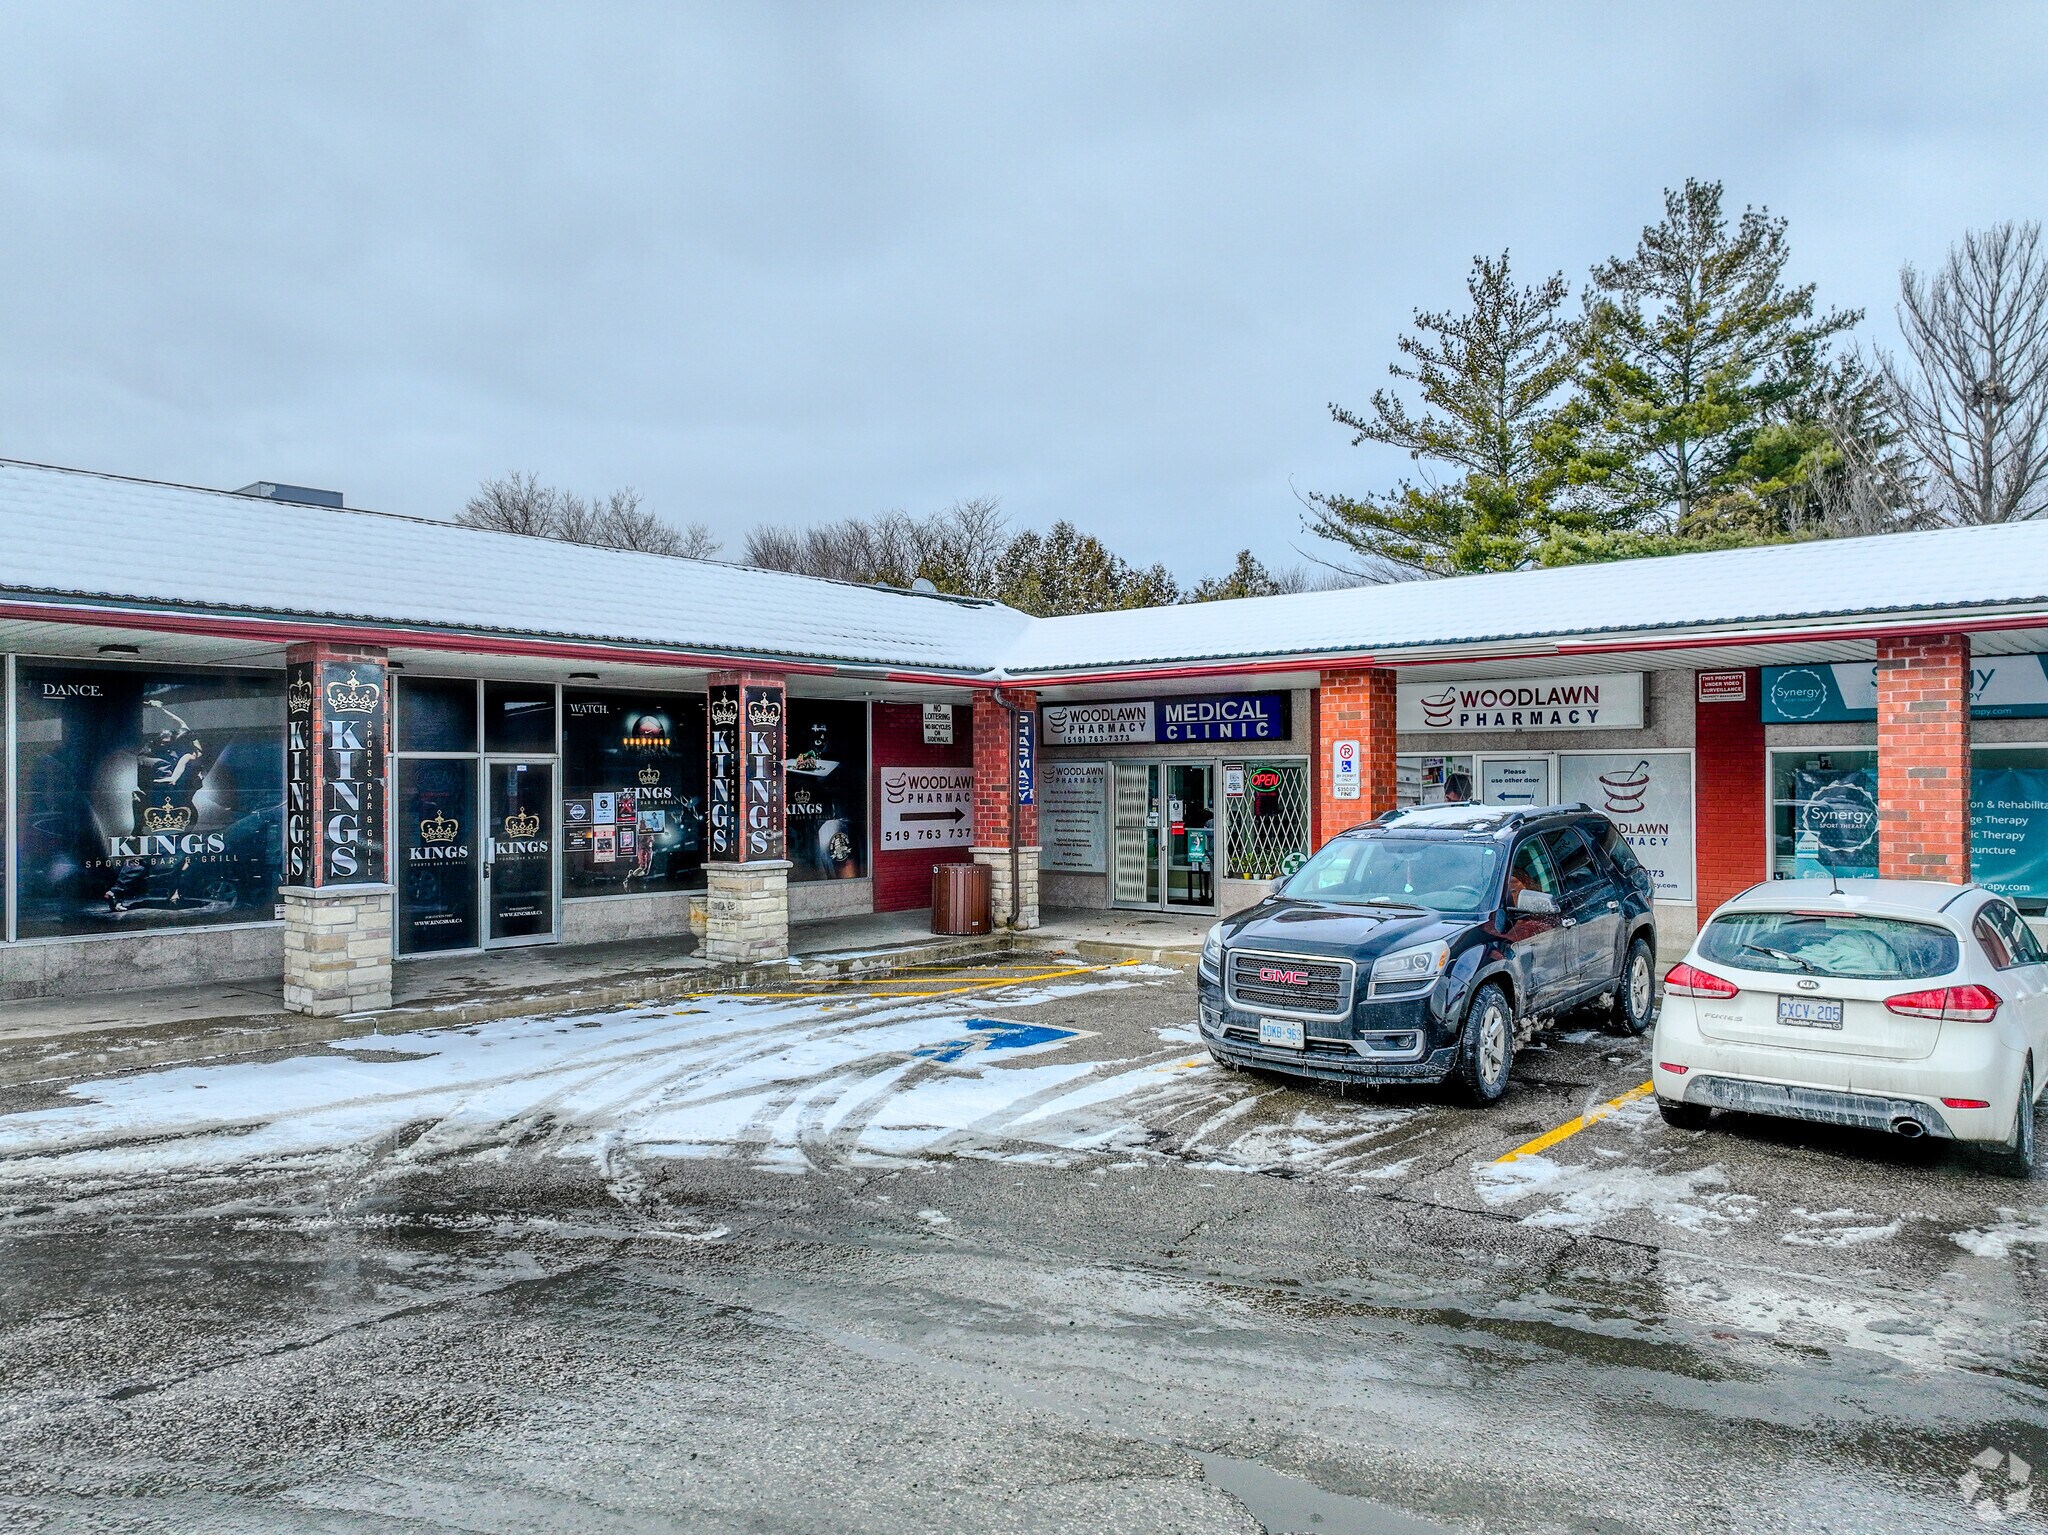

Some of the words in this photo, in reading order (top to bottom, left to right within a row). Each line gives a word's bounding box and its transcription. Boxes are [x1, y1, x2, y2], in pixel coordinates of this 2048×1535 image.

[43, 683, 103, 696] DANCE.
[1459, 685, 1599, 708] WOODLAWN
[1777, 687, 1820, 699] Synergy
[570, 703, 609, 714] WATCH.
[933, 704, 942, 712] NO
[1069, 707, 1146, 722] WOODLAWN
[1165, 700, 1269, 722] MEDICAL
[925, 713, 951, 721] LOITERING
[1460, 709, 1599, 727] PHARMACY
[1069, 722, 1146, 734] PHARMACY
[1166, 722, 1269, 740] CLINIC
[1063, 736, 1086, 744] (519)
[1088, 735, 1130, 743] 763-7373
[1056, 767, 1104, 776] WOODLAWN
[1251, 774, 1280, 786] OPEN
[289, 721, 306, 876] KINGS
[327, 720, 366, 877] KINGS
[711, 730, 731, 853] KINGS
[748, 731, 772, 854] KINGS
[908, 792, 971, 803] PHARMAC
[1986, 800, 1995, 809] &
[366, 815, 373, 824] &
[1811, 808, 1873, 824] Synergy
[1984, 815, 2029, 826] Therapy
[885, 831, 910, 842] 519
[918, 829, 941, 840] 763
[948, 828, 971, 839] 737
[1618, 823, 1669, 835] DLAWN
[1982, 830, 2026, 842] Therapy
[108, 833, 226, 858] KINGS
[496, 841, 549, 855] KINGS
[1626, 837, 1669, 846] MACY
[409, 845, 468, 861] KINGS
[85, 858, 140, 869] SPORTS
[151, 857, 175, 866] BAR
[201, 855, 239, 863] GRILL
[1260, 968, 1308, 985] GMC
[1780, 1003, 1810, 1019] CXCV
[1817, 1005, 1840, 1021] 205
[1286, 1027, 1302, 1041] 963
